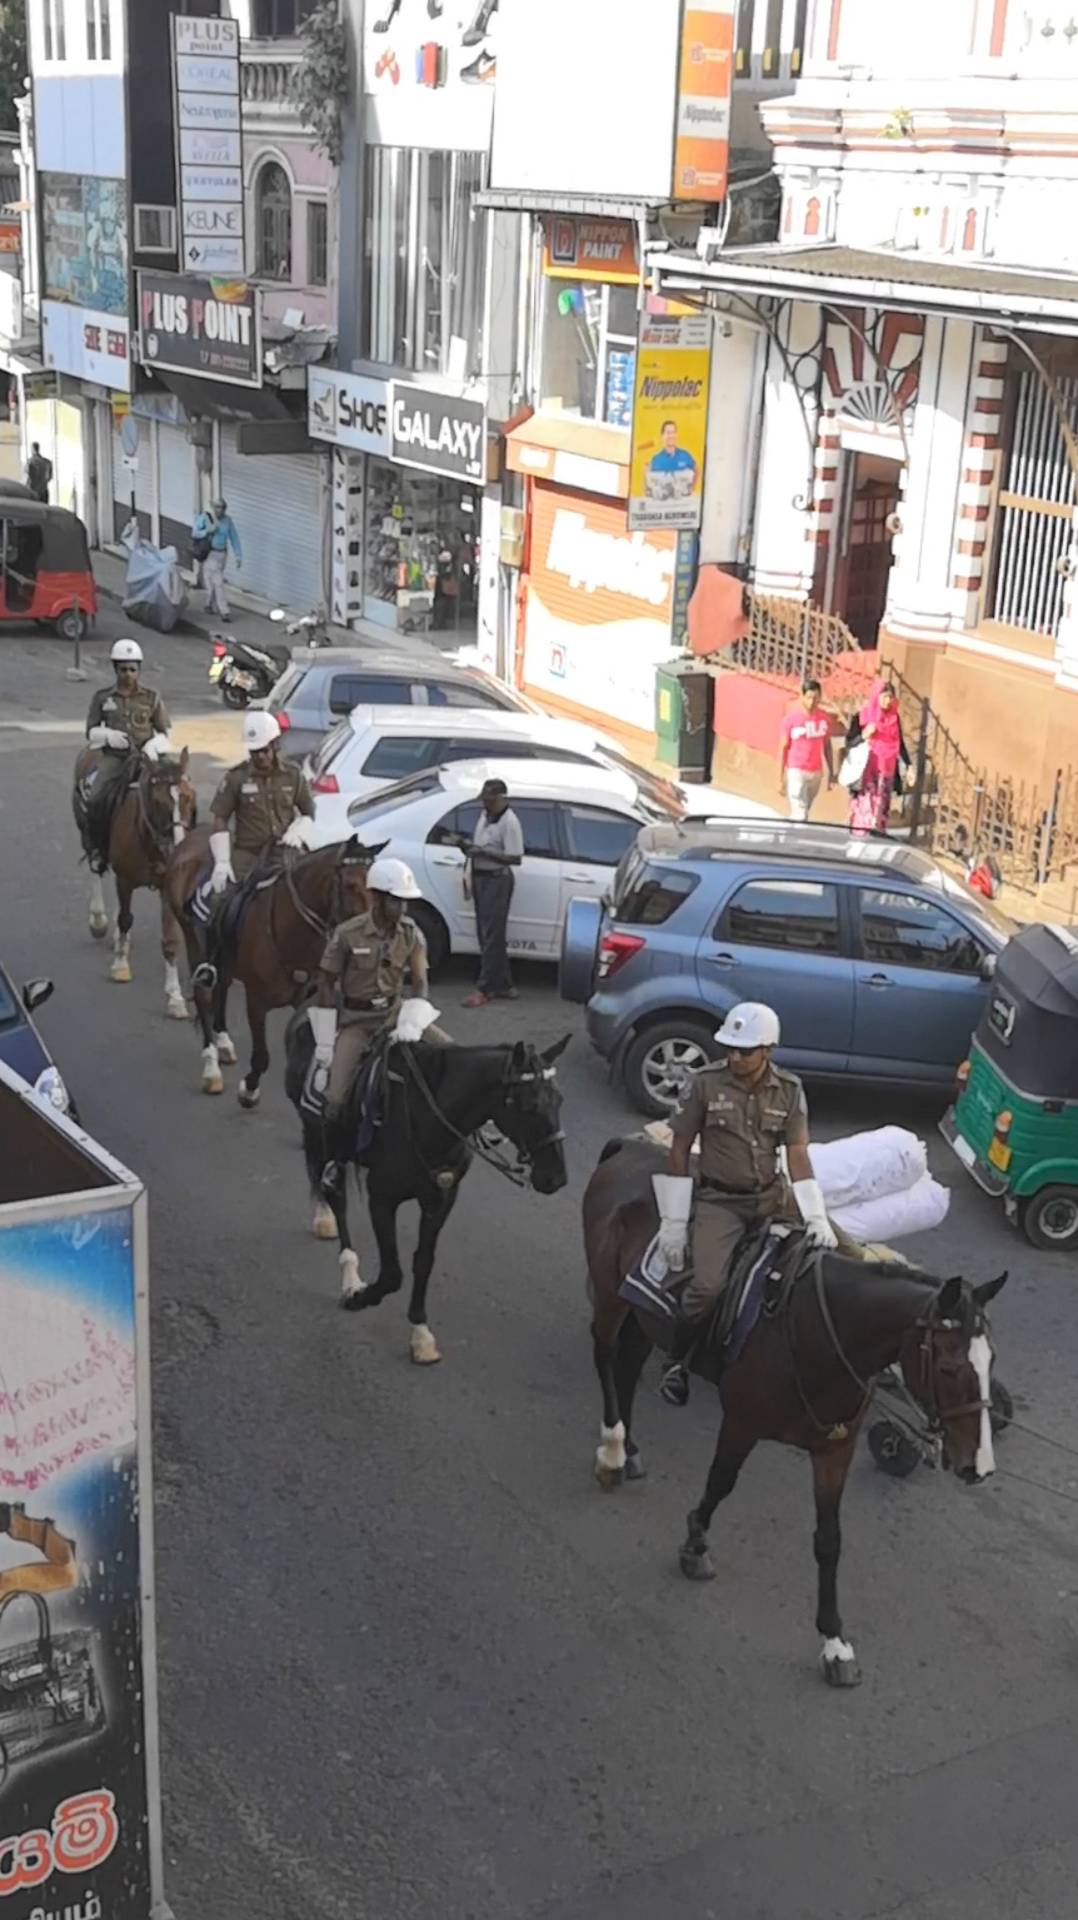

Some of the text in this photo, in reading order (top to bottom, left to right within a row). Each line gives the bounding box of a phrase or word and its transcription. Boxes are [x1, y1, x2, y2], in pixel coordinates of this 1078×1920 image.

[179, 21, 235, 41] PLUS
[579, 223, 629, 242] NIPPON
[583, 240, 623, 260] PAINT
[142, 290, 252, 346] PLUS POINT
[640, 375, 704, 401] Nippolac
[338, 388, 482, 460] SHOE GALAXY
